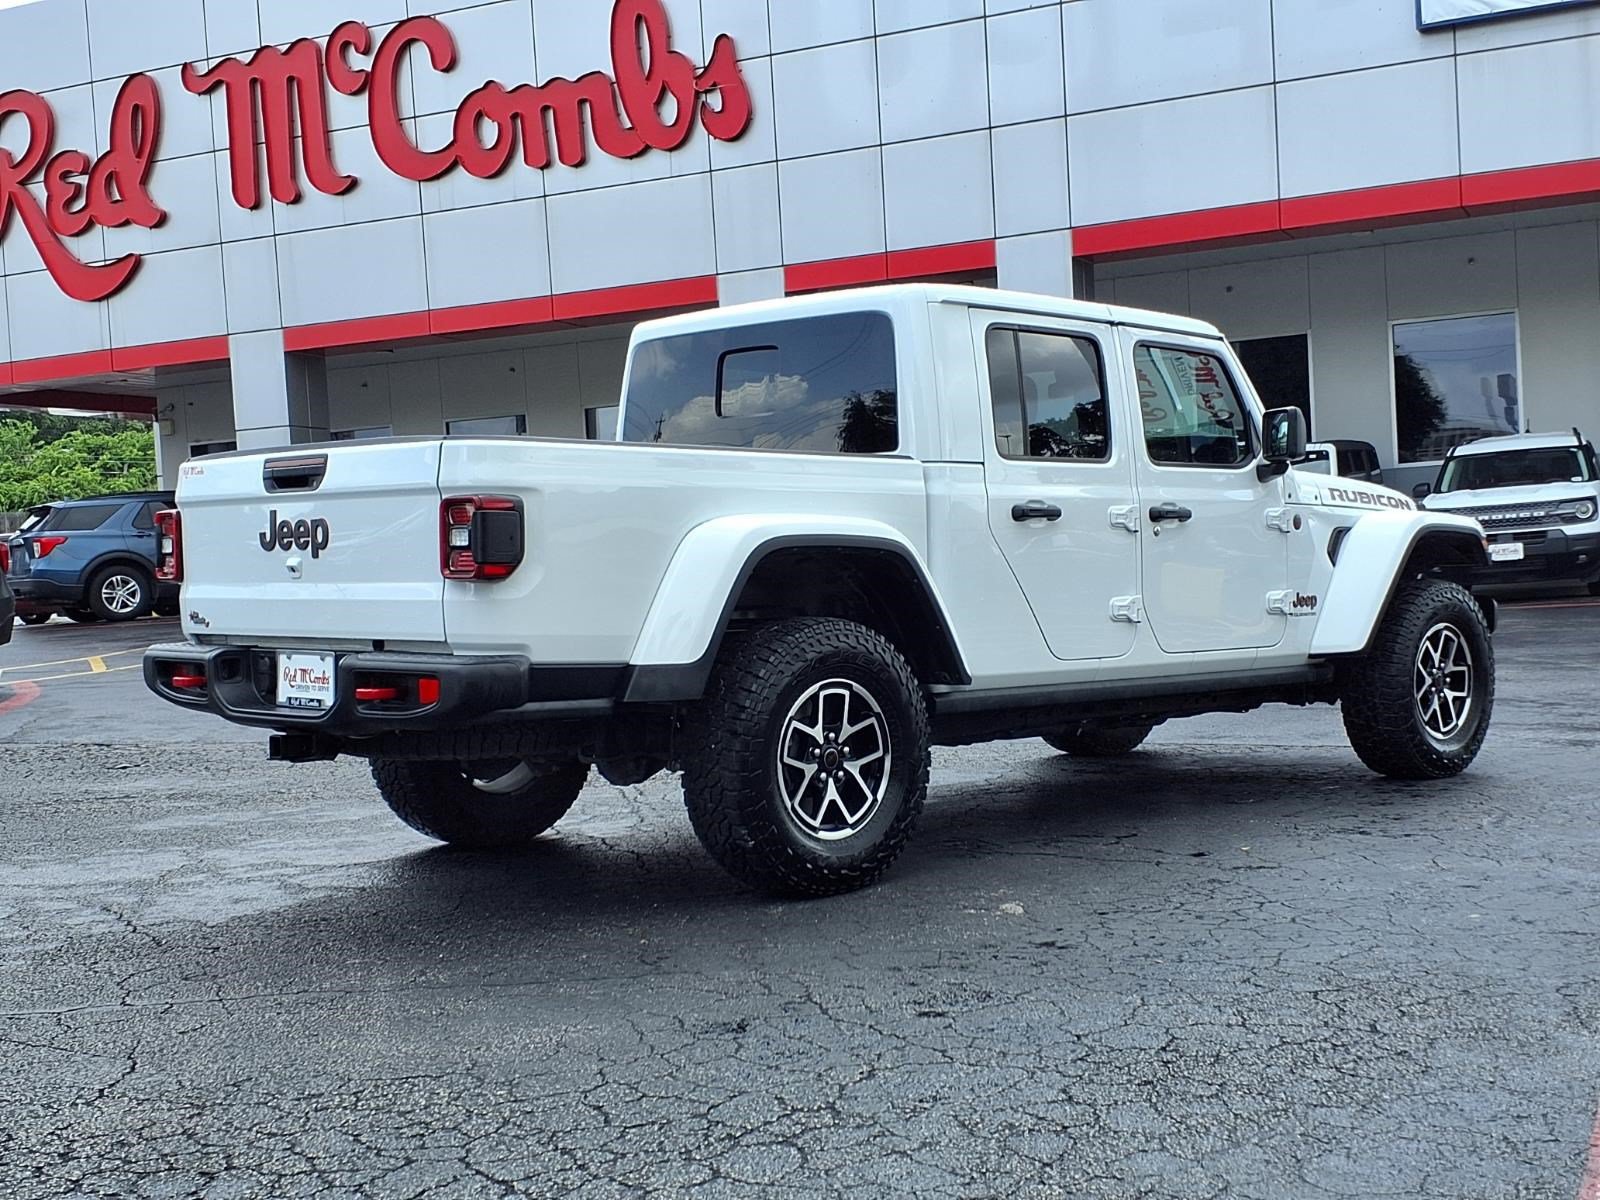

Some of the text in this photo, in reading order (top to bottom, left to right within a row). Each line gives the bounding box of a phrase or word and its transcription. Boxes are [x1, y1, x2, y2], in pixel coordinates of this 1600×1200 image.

[0, 0, 752, 302] Red McCombs
[1328, 487, 1412, 511] RUBICON
[259, 509, 329, 559] Jeep
[1292, 591, 1318, 611] Jeep
